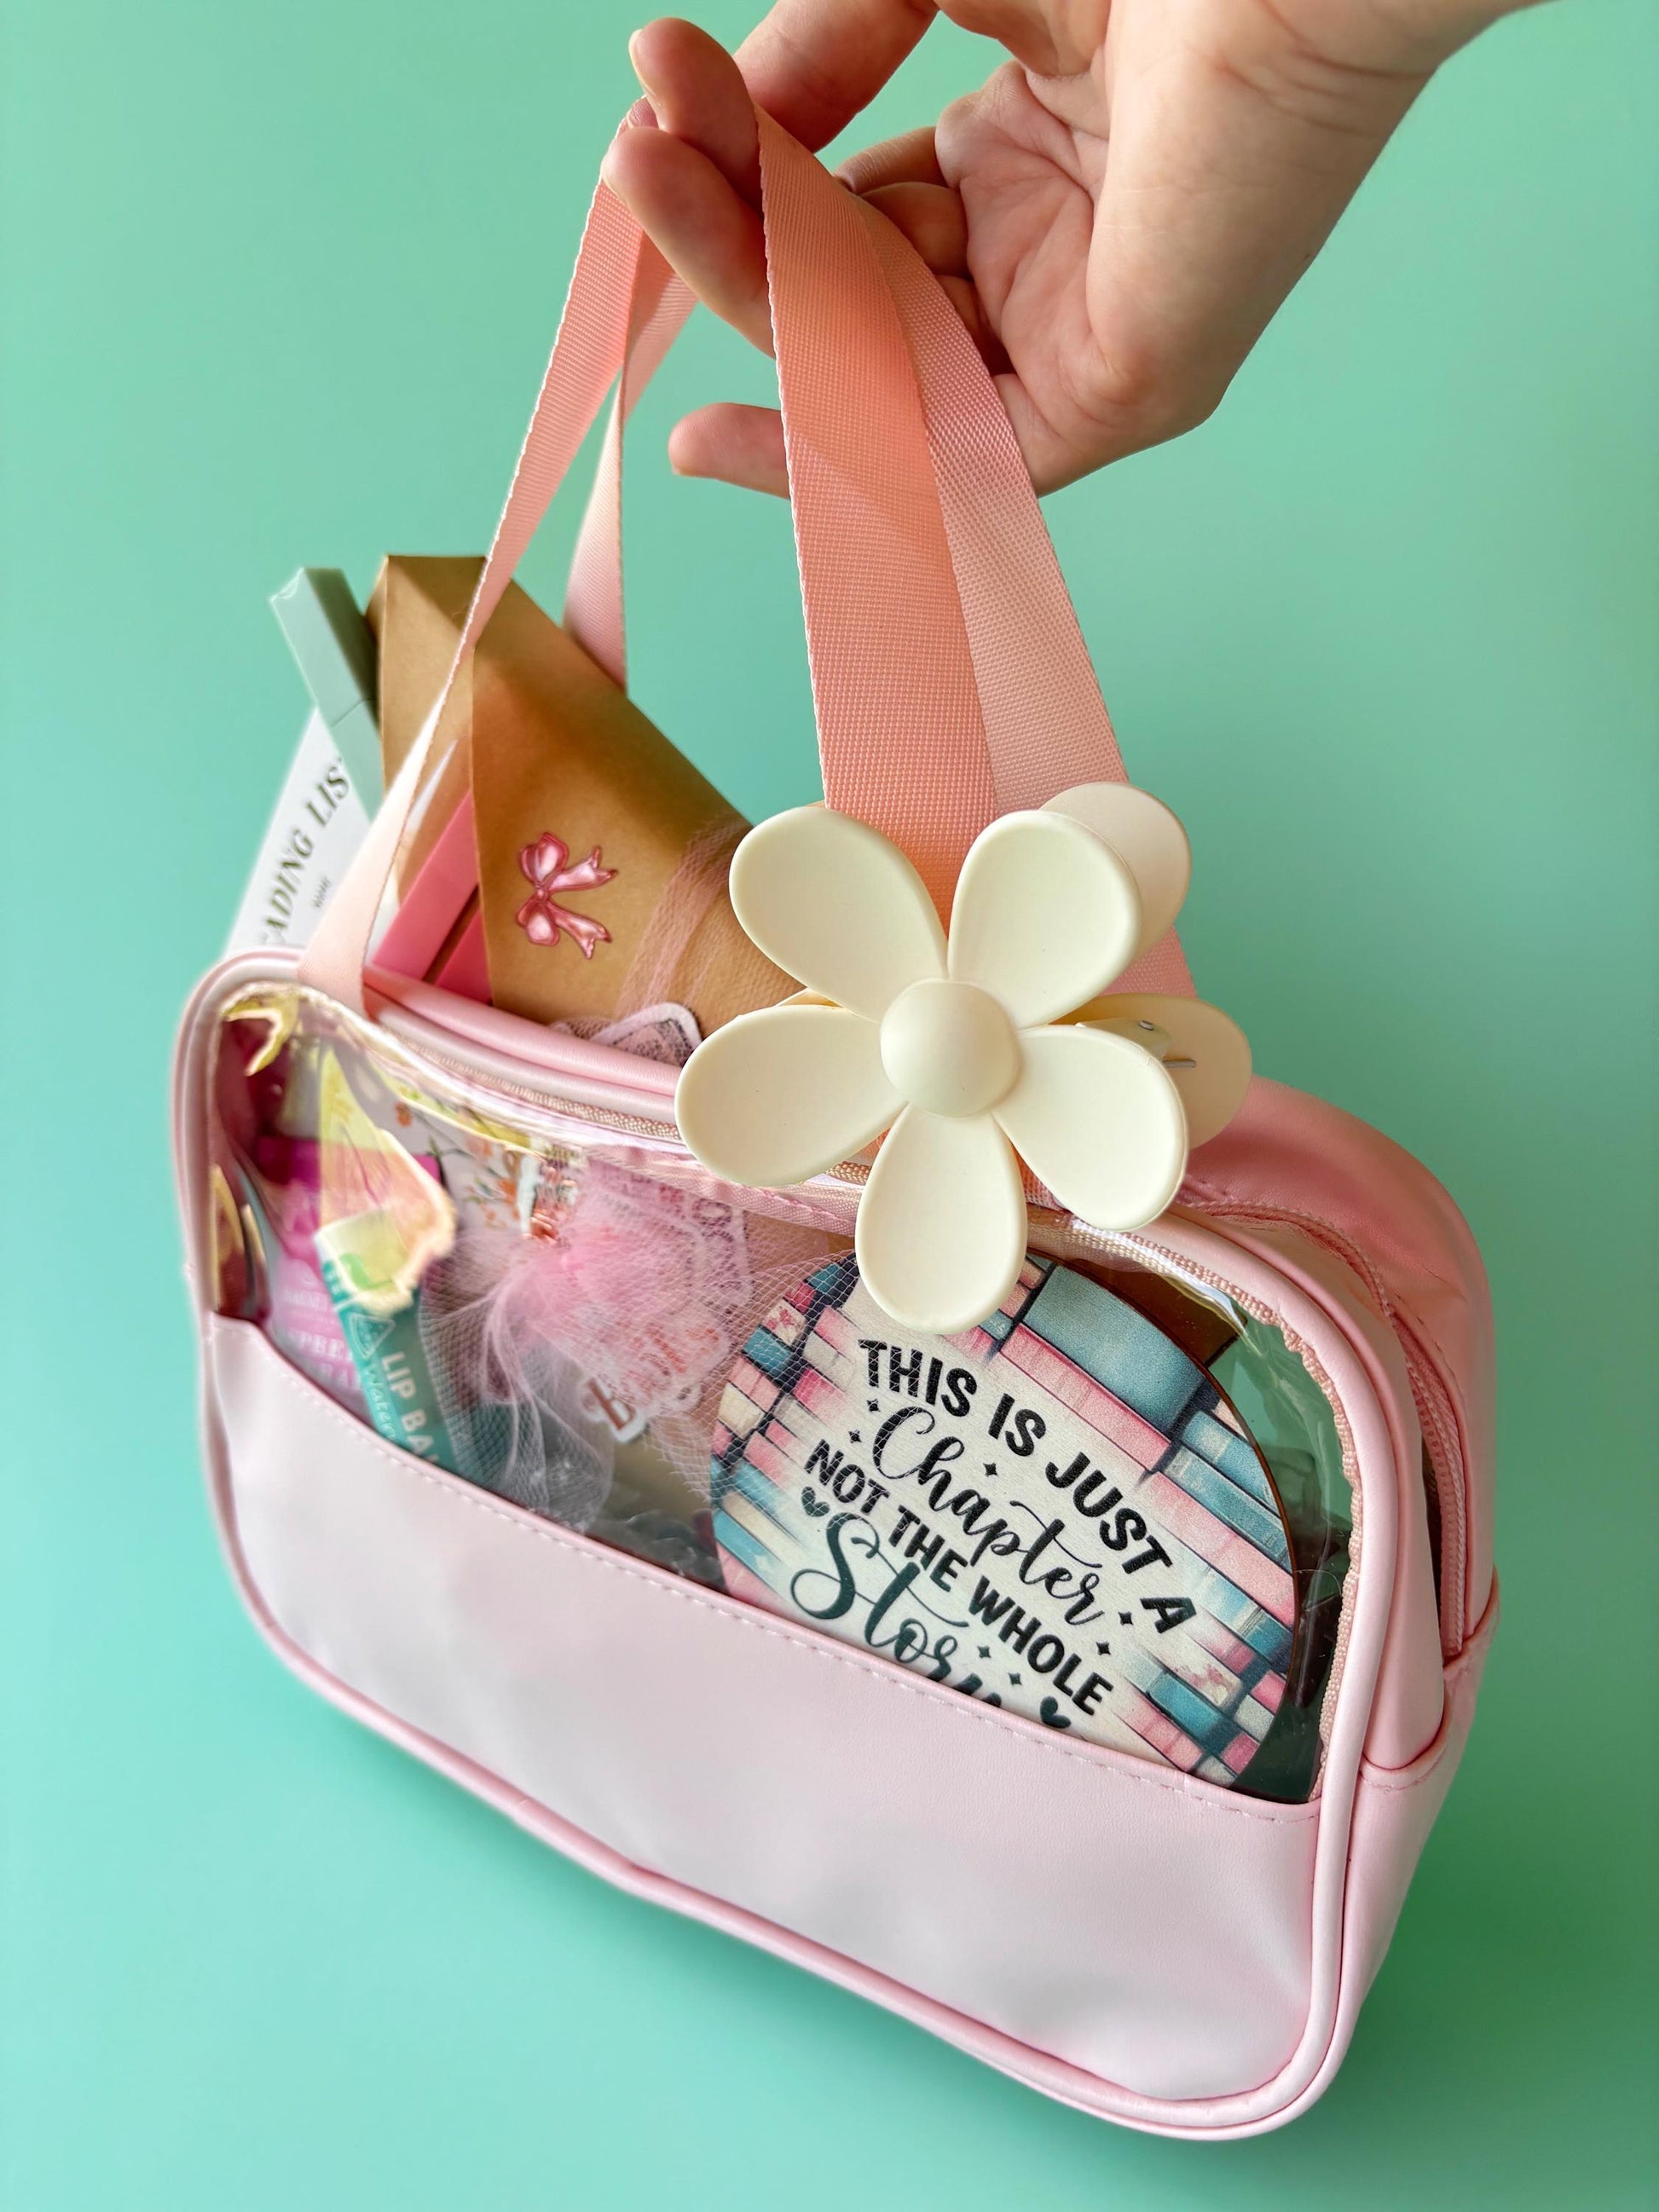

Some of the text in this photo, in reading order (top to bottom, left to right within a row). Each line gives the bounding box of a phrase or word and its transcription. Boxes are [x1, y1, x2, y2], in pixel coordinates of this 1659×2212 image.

[261, 757, 350, 945] ADING LIS
[367, 1365, 396, 1439] Water
[382, 1351, 416, 1399] LIP
[804, 1439, 1114, 1716] NOT THE WHOLE
[858, 1338, 1197, 1634] THIS IS JUST A
[872, 1406, 1105, 1626] Chapter
